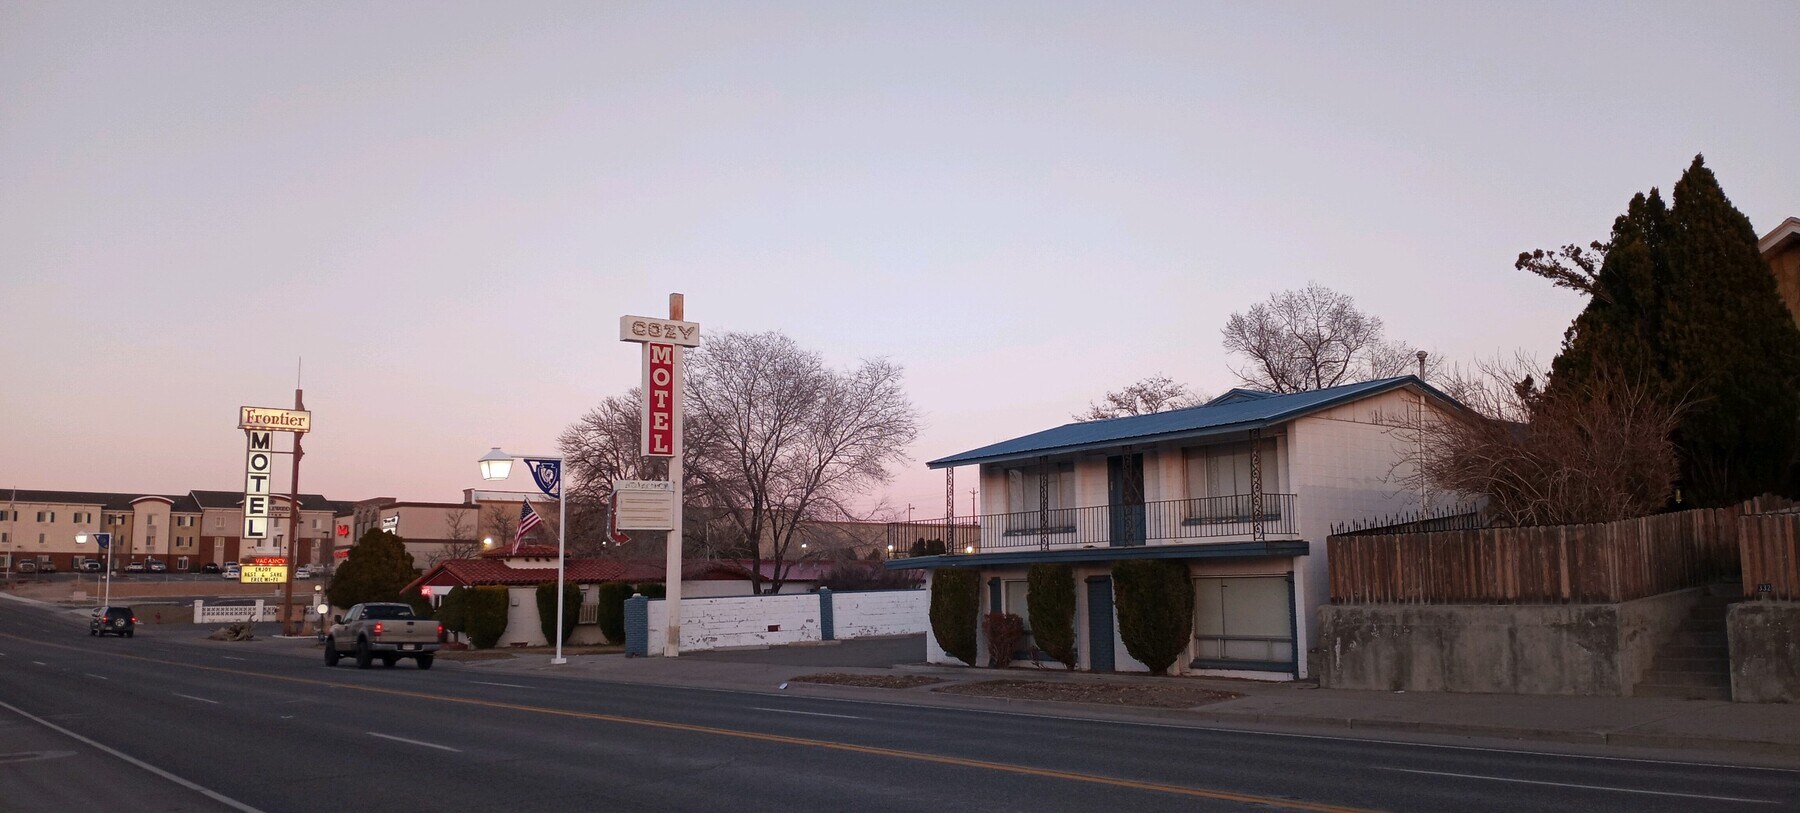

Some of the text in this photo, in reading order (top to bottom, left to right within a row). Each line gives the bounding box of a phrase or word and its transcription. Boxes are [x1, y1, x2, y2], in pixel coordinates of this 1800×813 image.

[632, 321, 695, 340] COZY
[245, 409, 305, 426] Frontier
[651, 345, 672, 453] MOTEL
[248, 432, 270, 537] MOTEL
